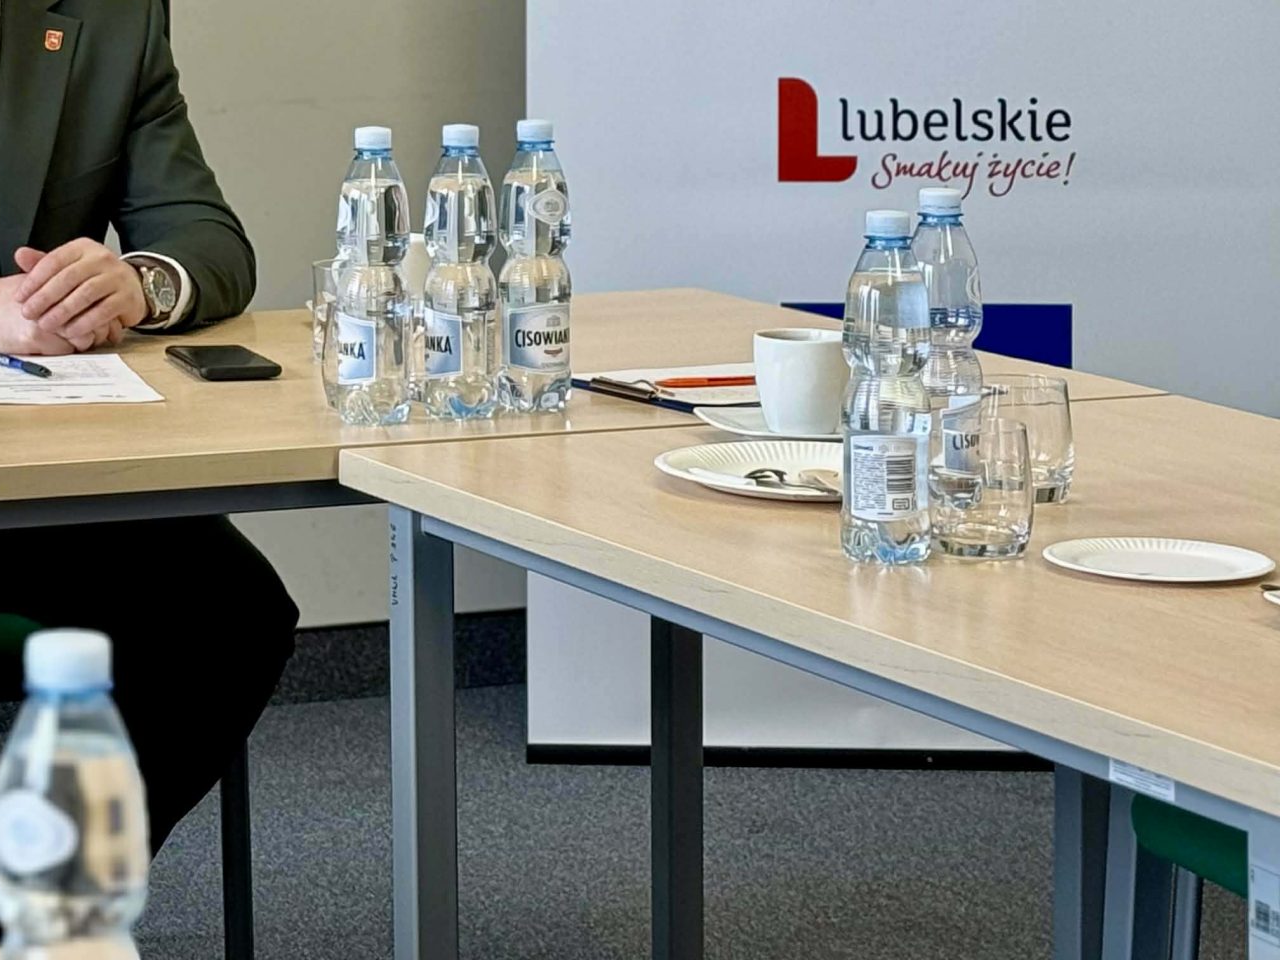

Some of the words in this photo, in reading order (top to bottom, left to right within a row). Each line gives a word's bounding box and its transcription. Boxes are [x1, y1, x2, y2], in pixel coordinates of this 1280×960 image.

[839, 97, 1072, 142] lubelskie
[871, 150, 984, 200] Smakuj
[987, 152, 1076, 197] życie!
